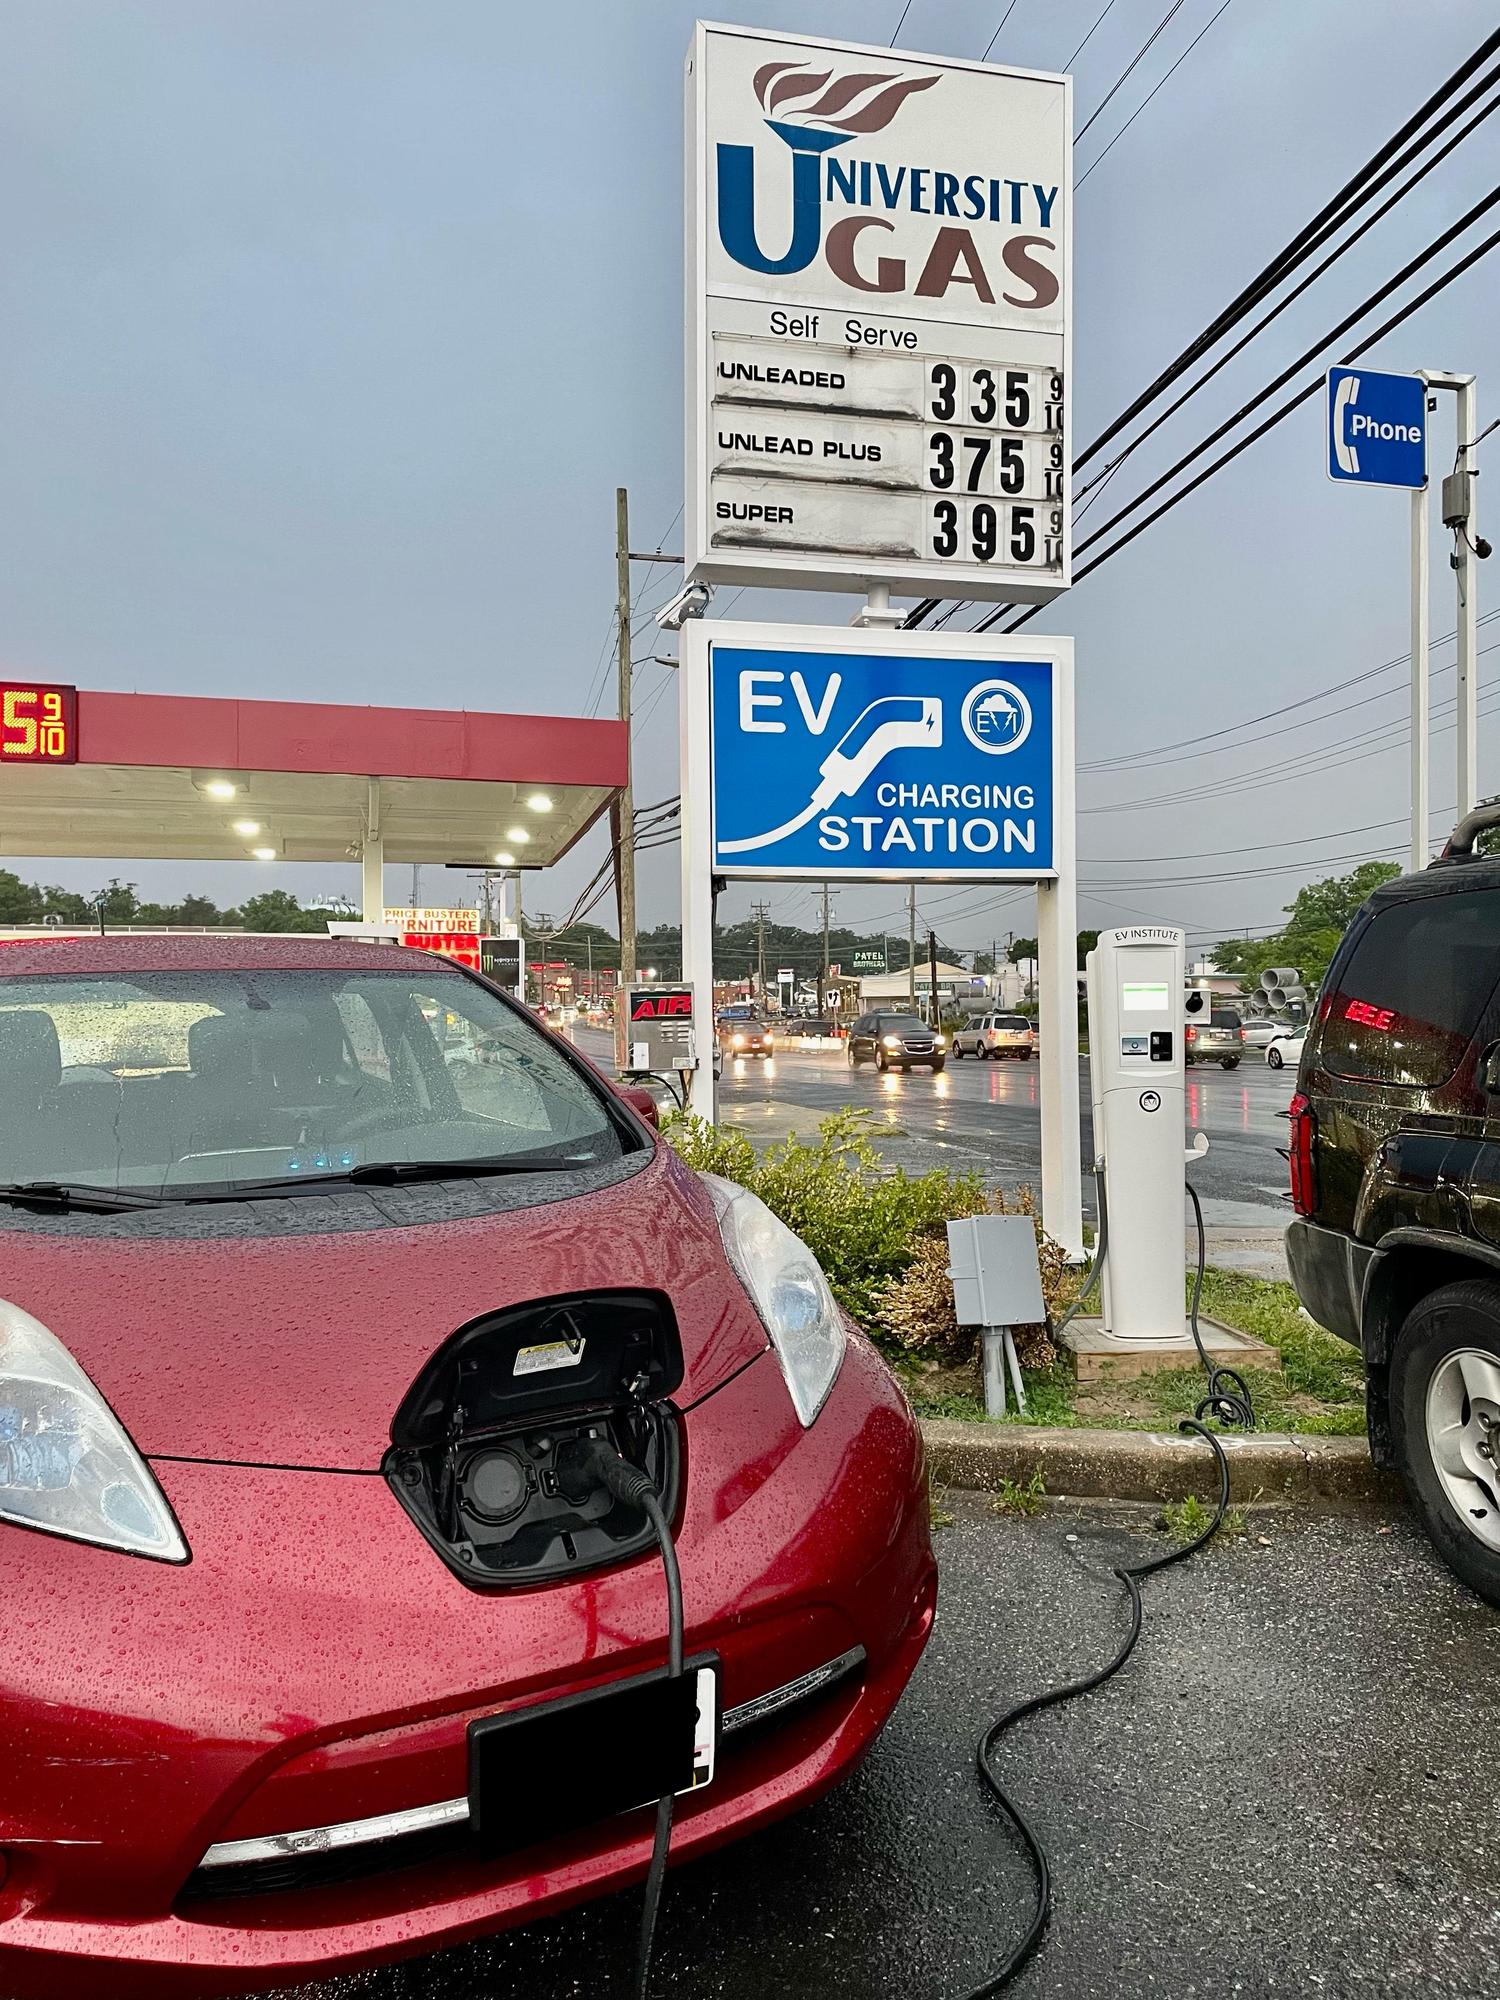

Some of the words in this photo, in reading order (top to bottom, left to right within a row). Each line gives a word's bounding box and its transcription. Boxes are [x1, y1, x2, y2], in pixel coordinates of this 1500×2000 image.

[716, 143, 1059, 275] UNIVERSITY
[825, 216, 1060, 309] GAS
[770, 311, 819, 339] Self
[845, 320, 919, 350] Serve
[719, 361, 846, 390] UNLEADED
[931, 363, 1031, 428] 335
[1352, 414, 1422, 443] Phone
[718, 431, 814, 456] UNLEAD
[823, 440, 882, 462] PLUS
[929, 431, 1025, 494] 375
[716, 502, 794, 524] SUPER
[933, 500, 1036, 561] 395
[739, 670, 842, 735] EV
[977, 711, 1017, 734] EVI
[877, 783, 1035, 809] CHARGING
[818, 816, 1036, 853] STATION
[384, 909, 420, 919] PRICE
[424, 909, 478, 919] BUSTERS
[1114, 930, 1128, 941] EV
[1131, 928, 1179, 941] INSTITUTE
[855, 951, 884, 960] PATEL
[631, 995, 692, 1021] AIR
